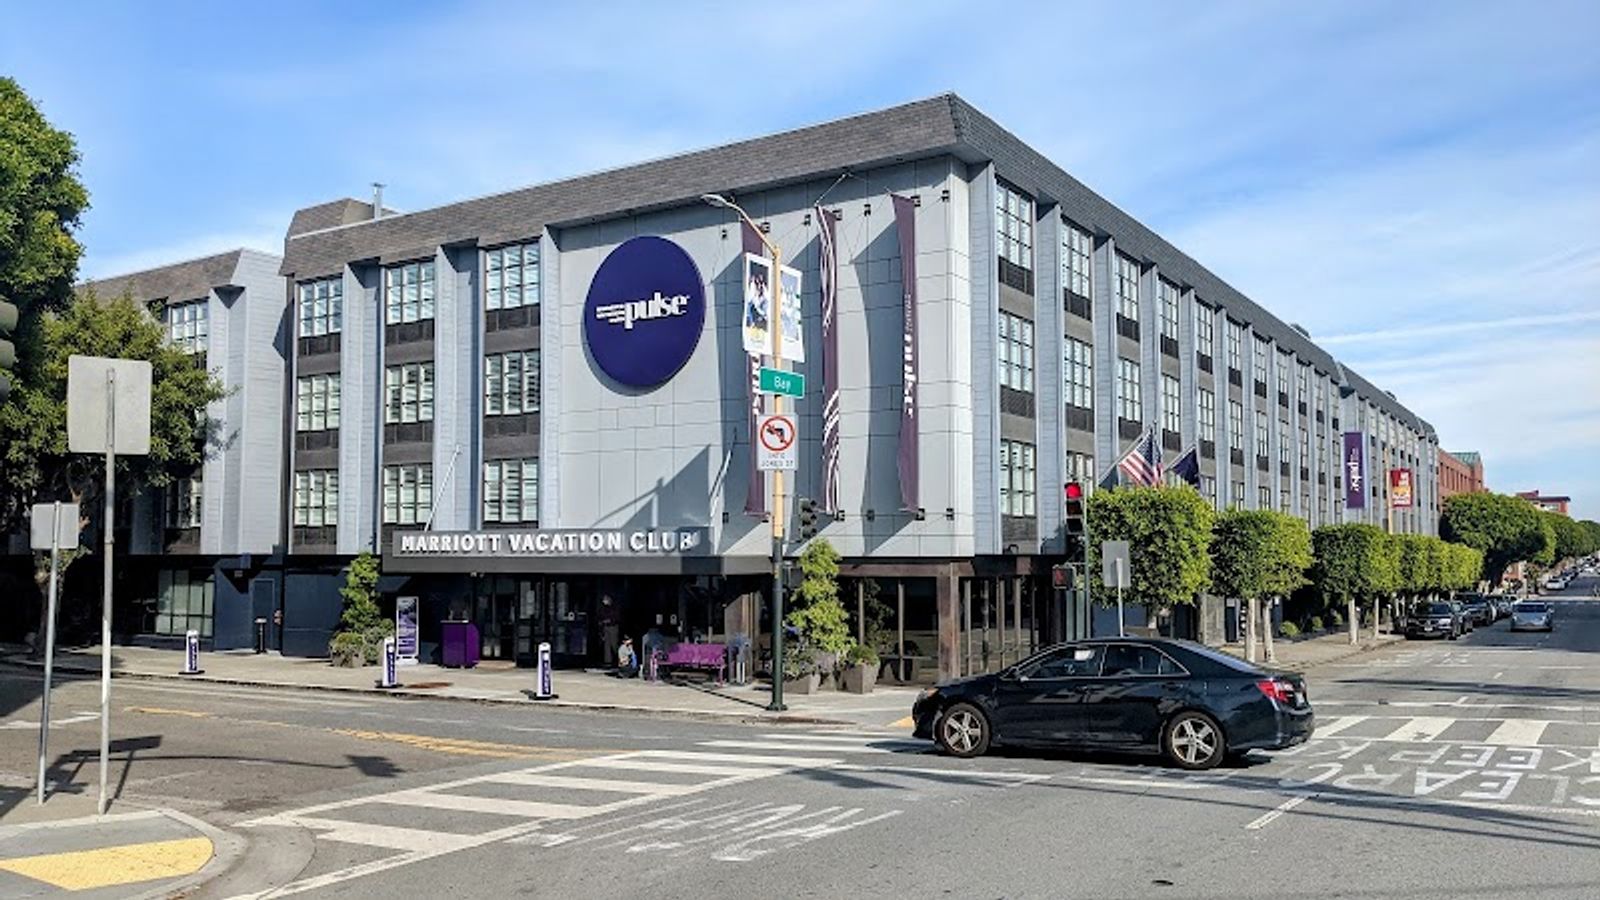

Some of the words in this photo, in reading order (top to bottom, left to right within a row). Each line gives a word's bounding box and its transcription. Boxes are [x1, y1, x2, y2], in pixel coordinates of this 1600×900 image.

[623, 292, 690, 329] pulse
[774, 376, 791, 393] Bay
[401, 534, 501, 552] MARRIOTT
[508, 532, 621, 552] VACATION
[630, 531, 699, 551] CLUB
[1388, 744, 1600, 773] KEEP
